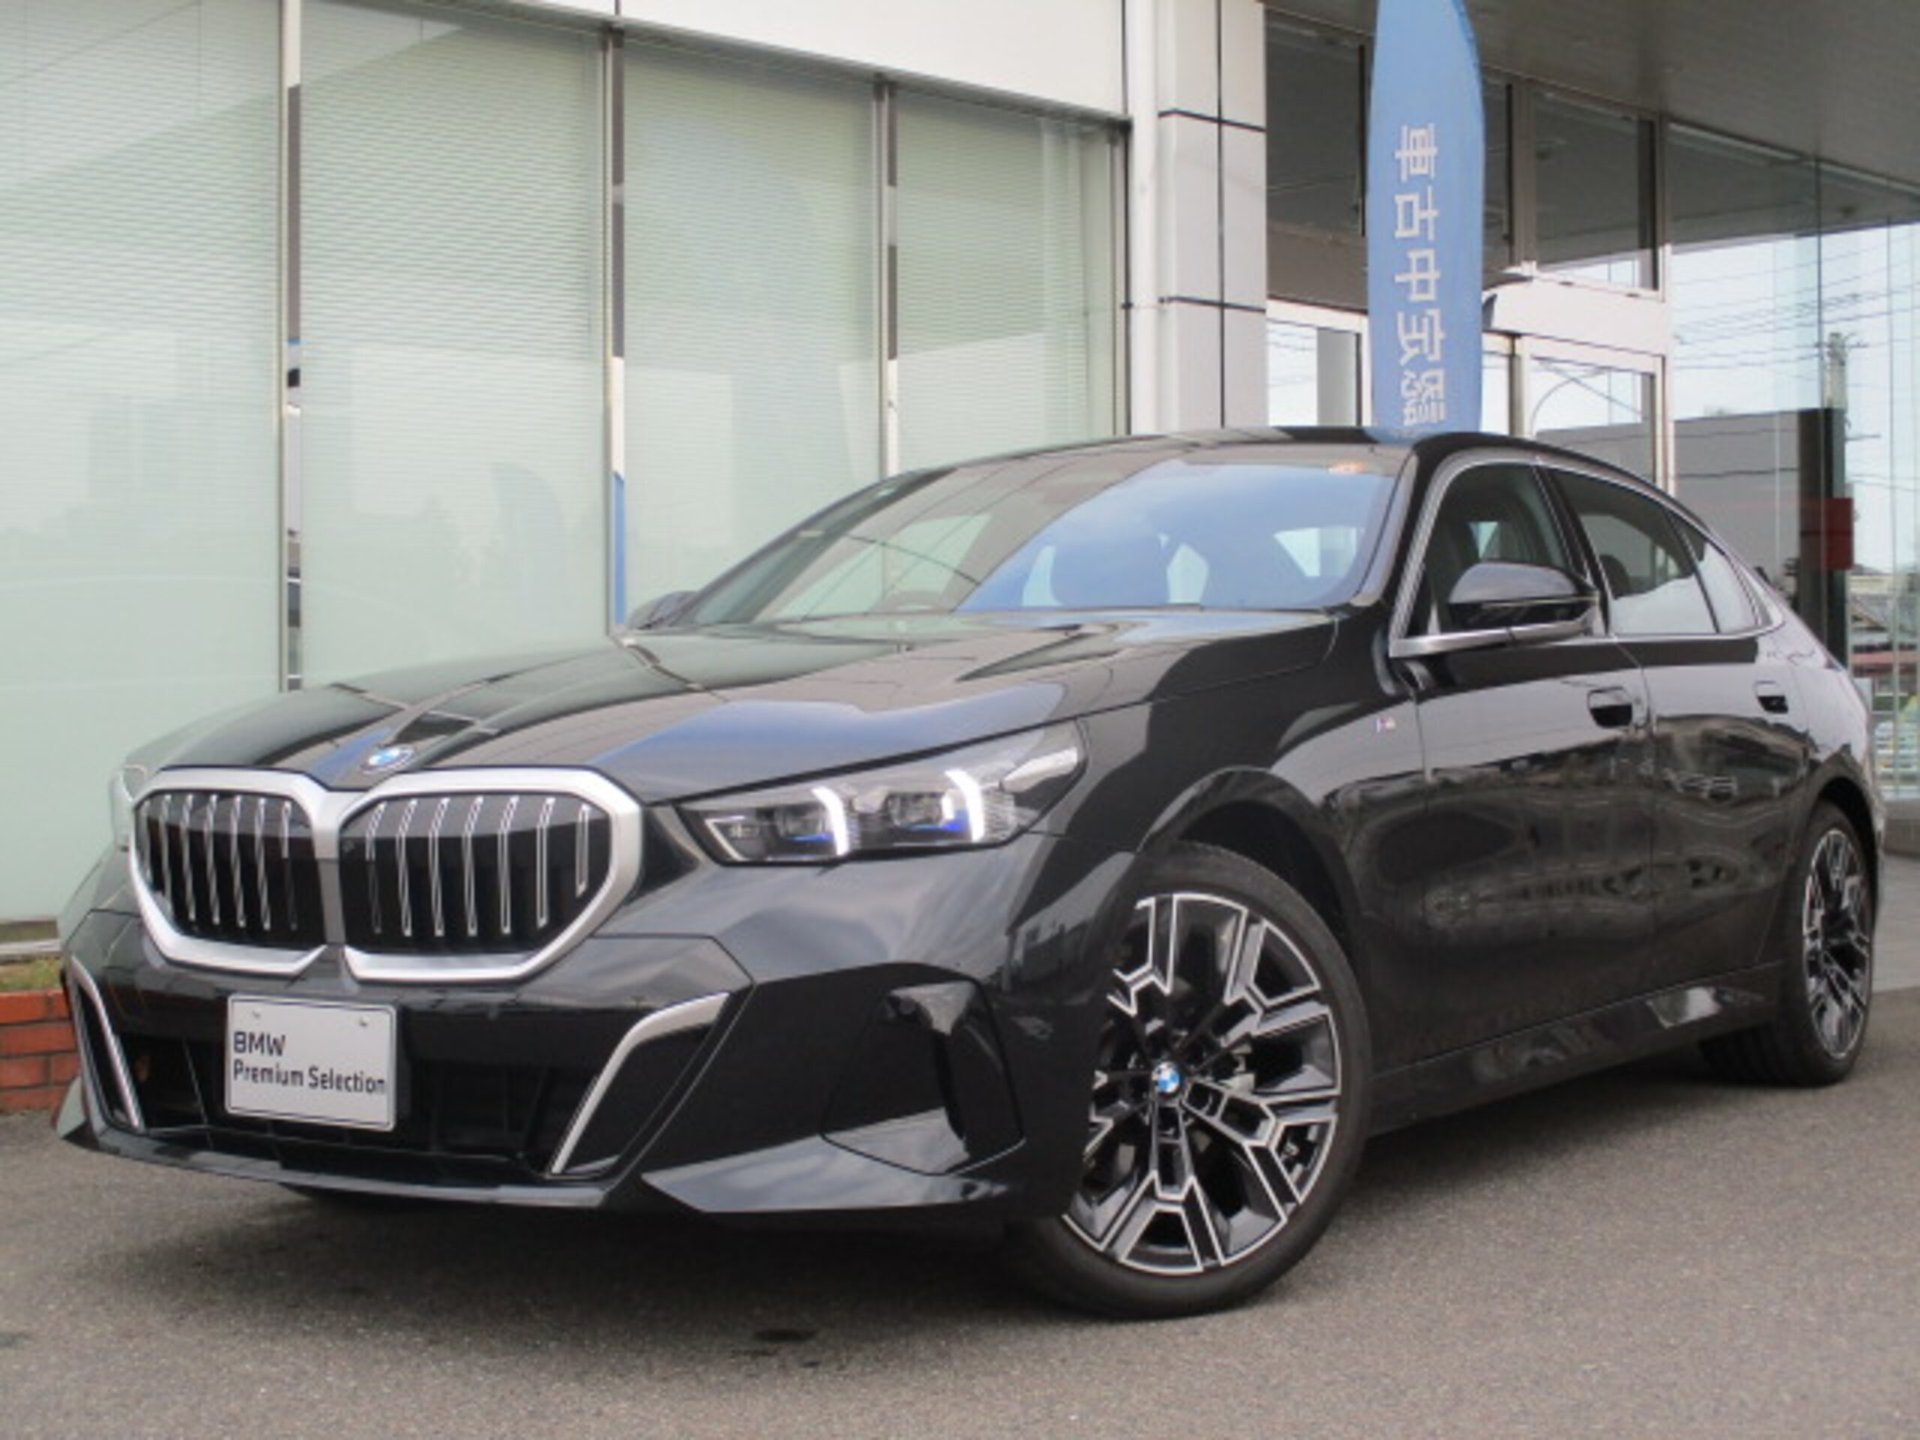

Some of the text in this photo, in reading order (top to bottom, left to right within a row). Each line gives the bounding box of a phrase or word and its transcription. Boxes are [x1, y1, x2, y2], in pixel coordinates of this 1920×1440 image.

[233, 1031, 286, 1056] BMW
[233, 1058, 385, 1095] Premium Selection
